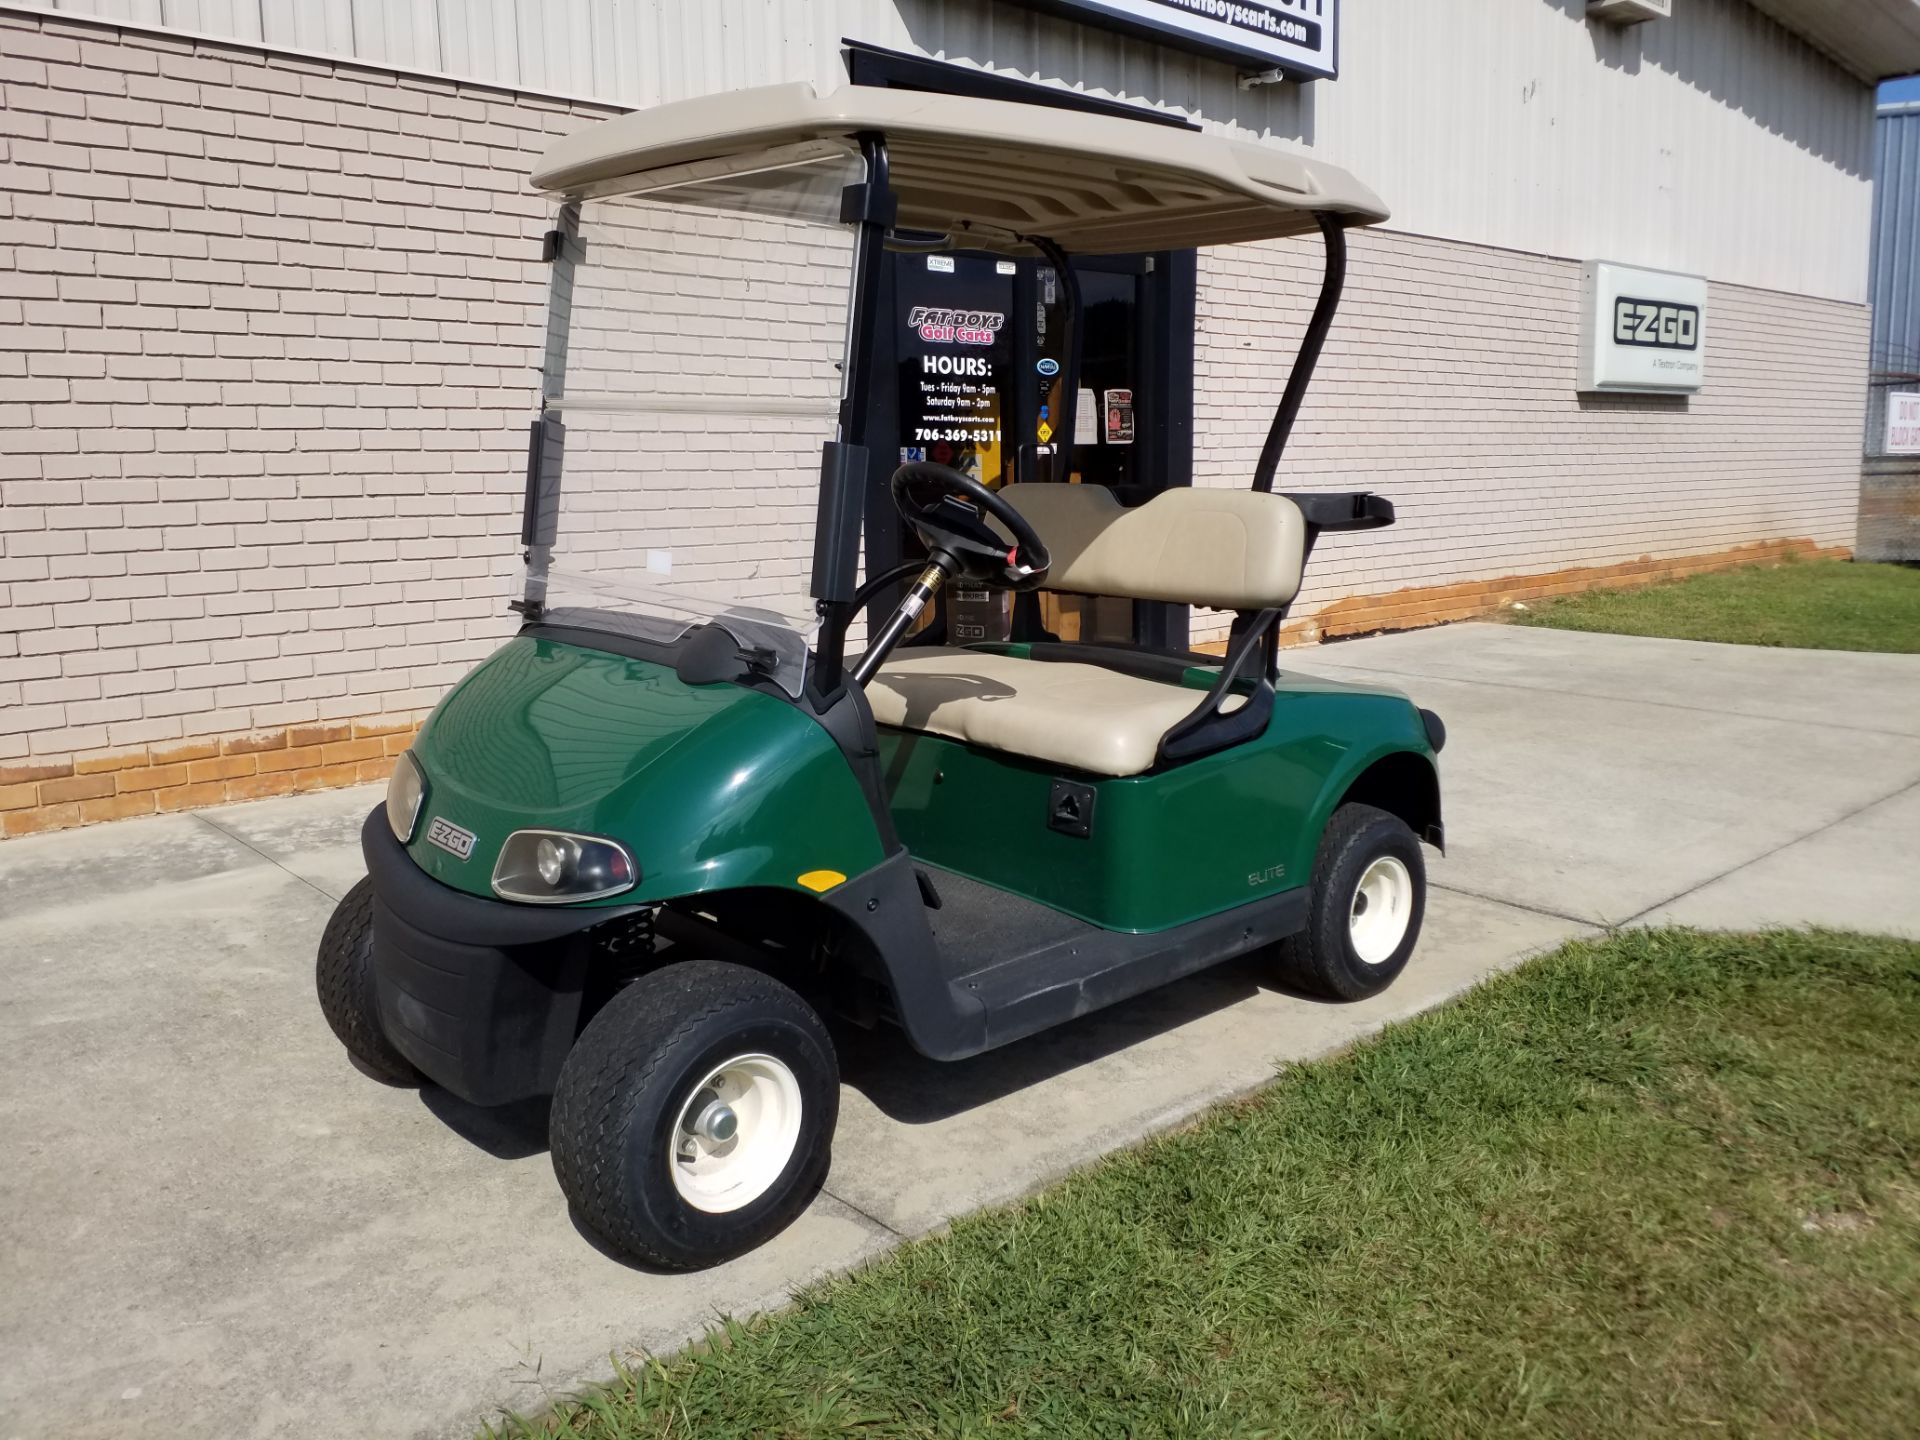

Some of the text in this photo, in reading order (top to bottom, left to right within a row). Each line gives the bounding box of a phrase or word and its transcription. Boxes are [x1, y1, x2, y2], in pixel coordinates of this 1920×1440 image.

[951, 310, 1004, 331] BOYS
[920, 325, 993, 343] Golf Carts
[923, 354, 992, 377] HOURS:
[920, 381, 935, 392] Tues
[941, 382, 961, 395] Friday
[962, 384, 976, 393] 9am
[982, 384, 996, 396] 5pm
[926, 396, 955, 409] Saturday
[956, 397, 971, 407] 9am
[976, 398, 991, 409] 2pm
[915, 428, 1002, 442] 706-369-5311
[1248, 863, 1285, 886] ELITE
